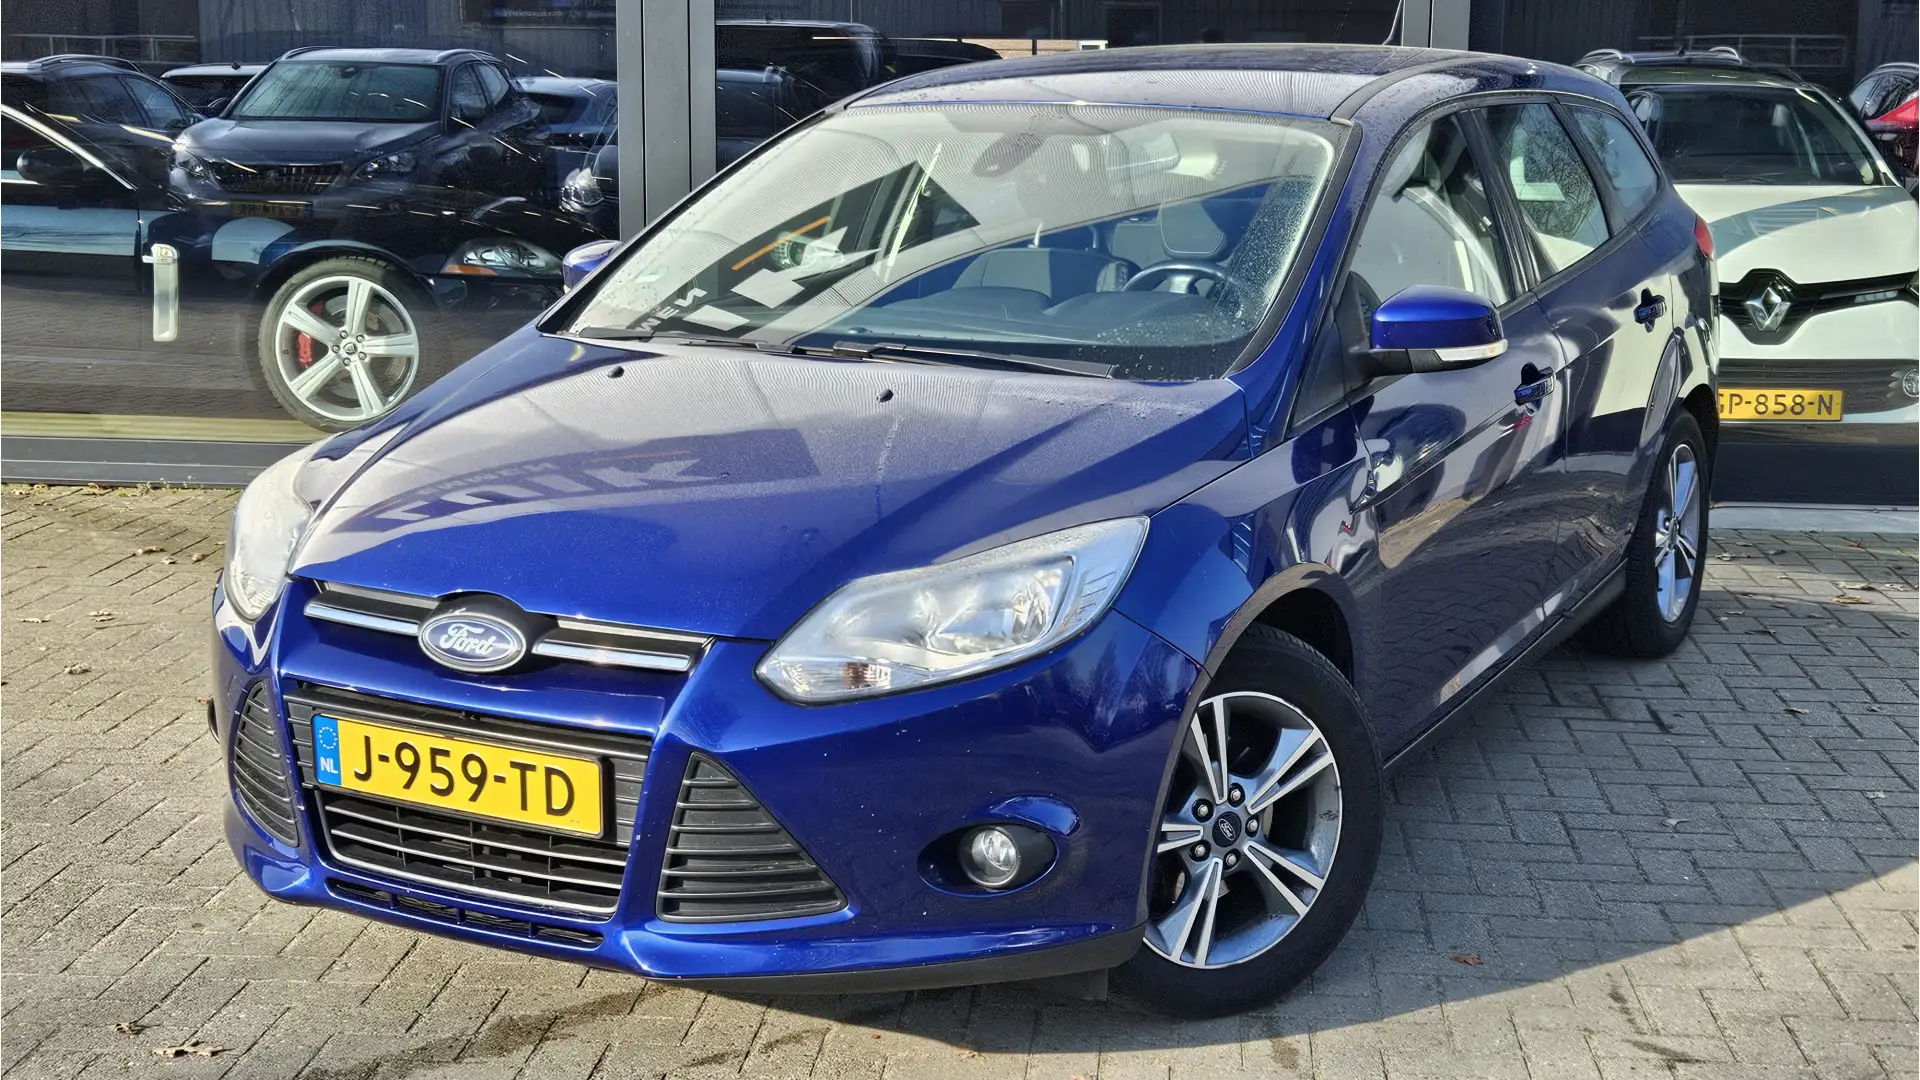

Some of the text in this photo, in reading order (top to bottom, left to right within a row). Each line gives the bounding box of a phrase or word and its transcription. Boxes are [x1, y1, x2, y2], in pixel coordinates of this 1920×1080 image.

[439, 623, 496, 656] Ford
[320, 756, 338, 774] NL
[354, 735, 575, 817] J-959-TD
